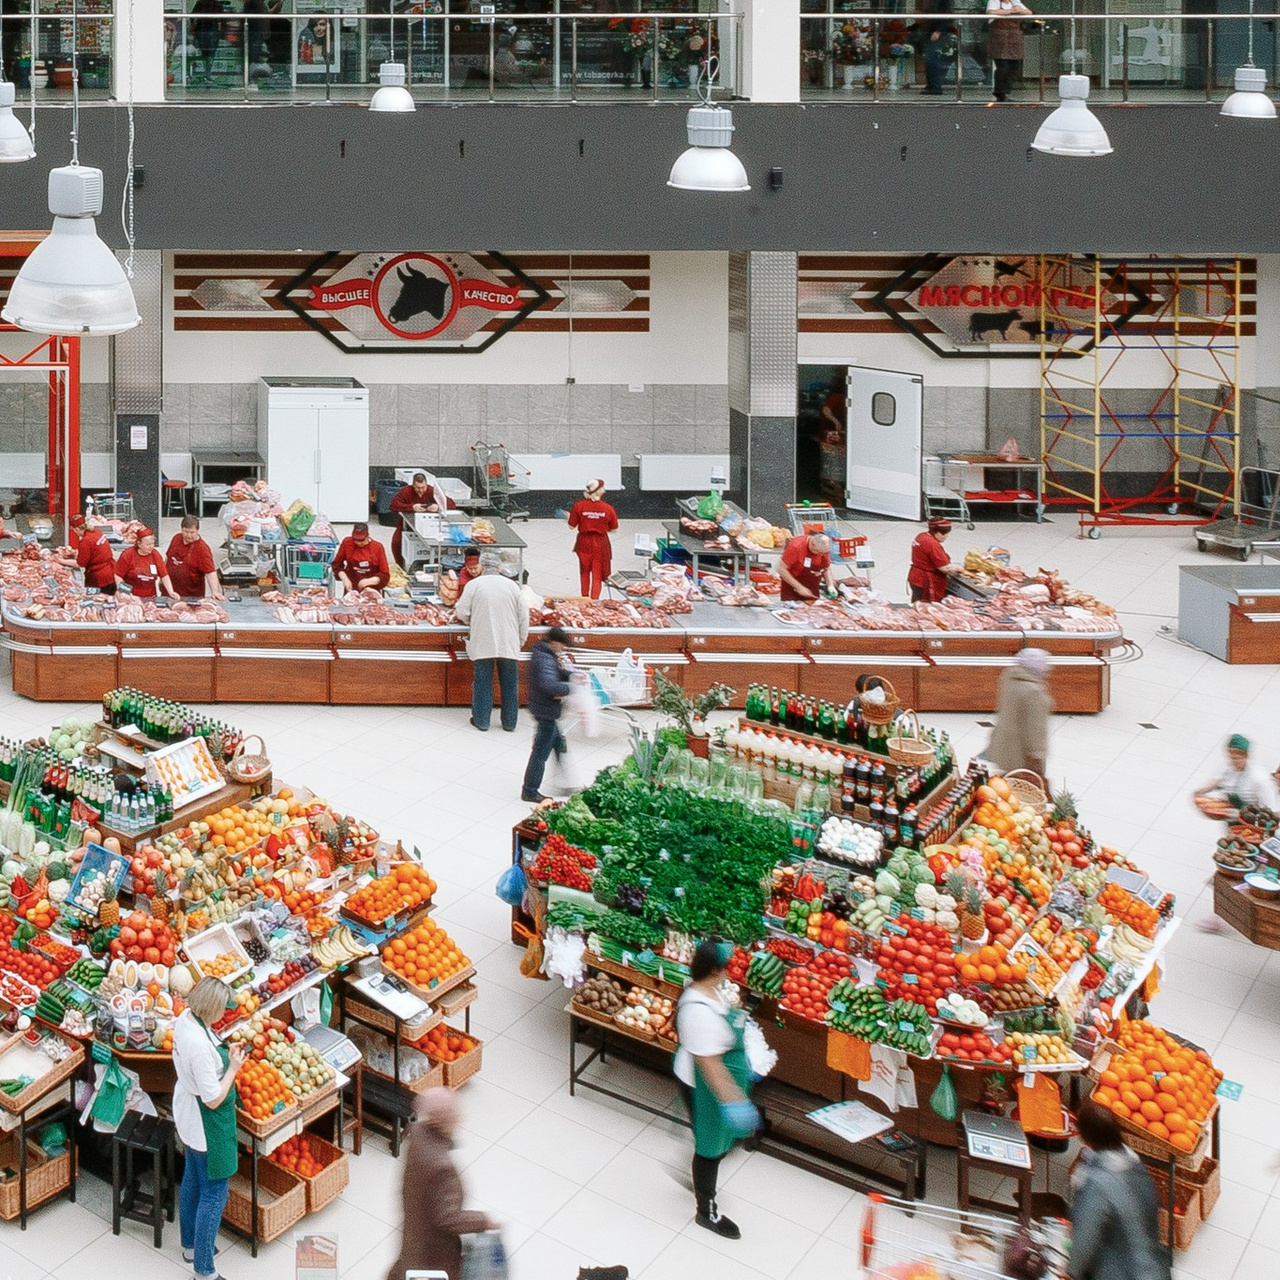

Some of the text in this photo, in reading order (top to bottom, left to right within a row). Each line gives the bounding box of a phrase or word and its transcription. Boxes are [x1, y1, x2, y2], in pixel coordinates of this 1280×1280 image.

[321, 289, 515, 305] ВЫСШЕЕ КАЧЕСТВО
[919, 281, 1042, 307] МЯСНОЙ
